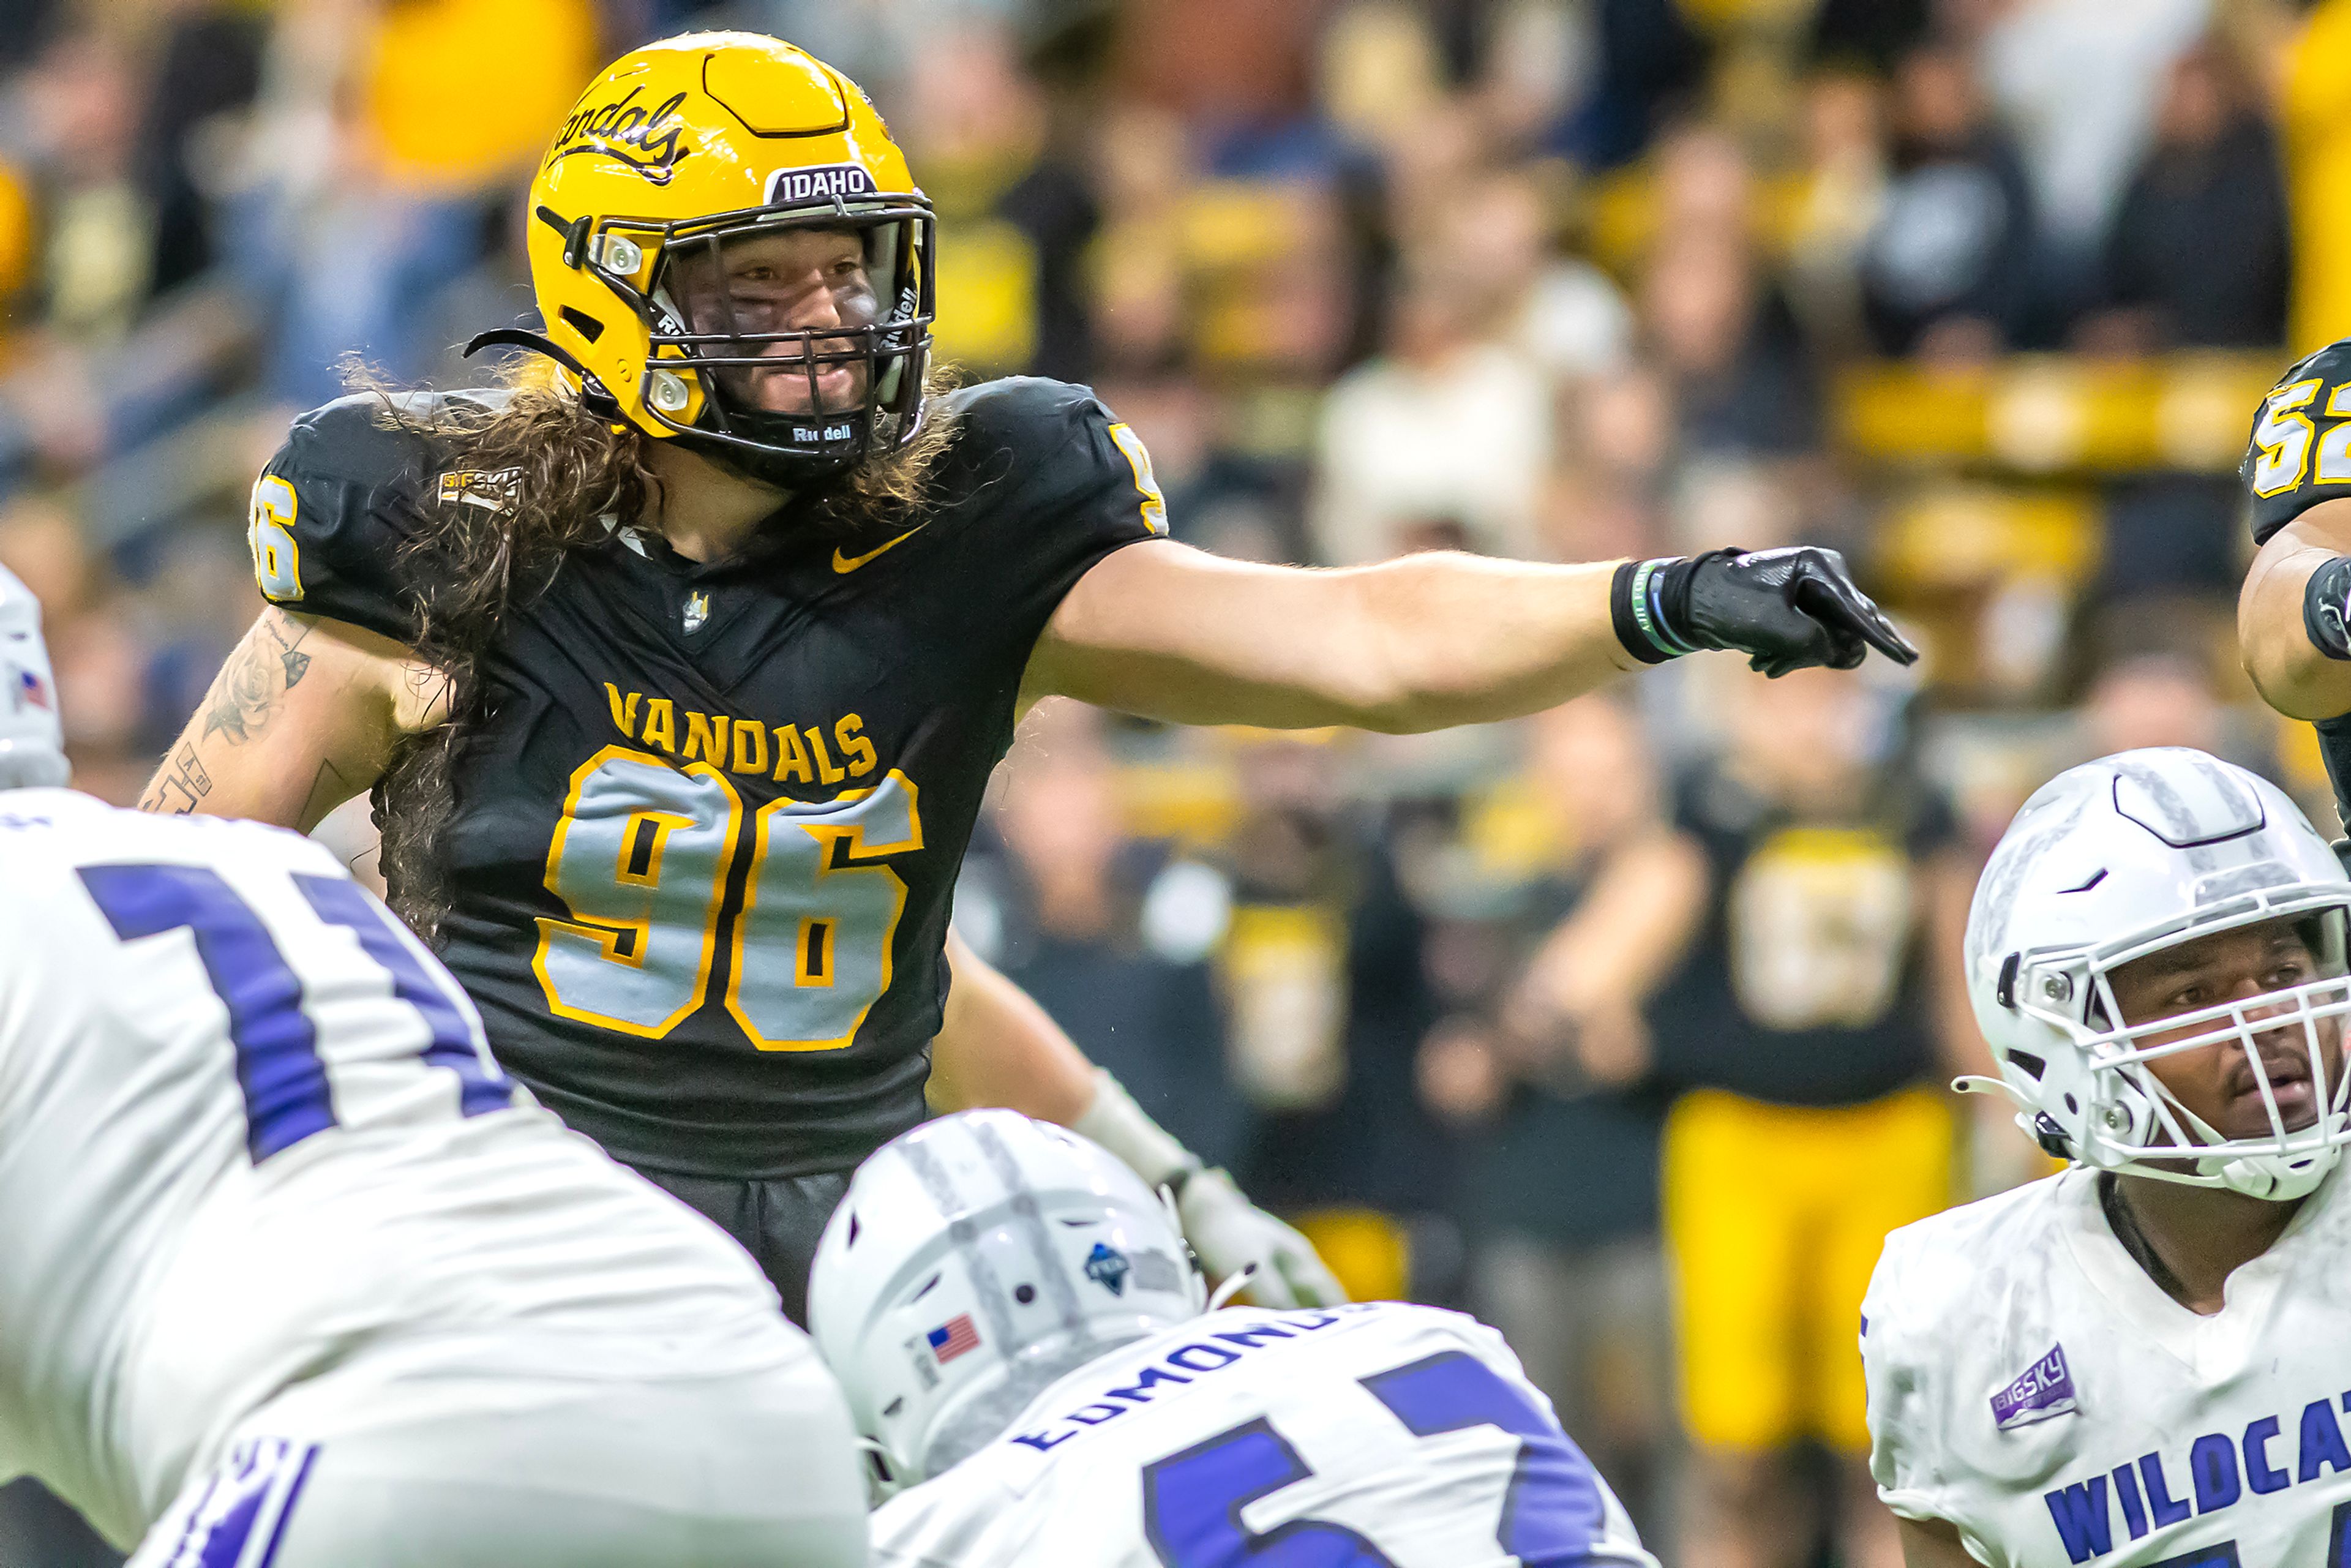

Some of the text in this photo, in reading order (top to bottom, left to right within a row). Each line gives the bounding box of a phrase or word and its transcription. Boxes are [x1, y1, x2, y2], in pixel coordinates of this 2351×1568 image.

[782, 170, 865, 202] IDAHO
[248, 459, 305, 601] 6
[604, 681, 878, 785] VANDALS
[531, 743, 924, 1052] 96
[2044, 1390, 2351, 1566] WILDCA
